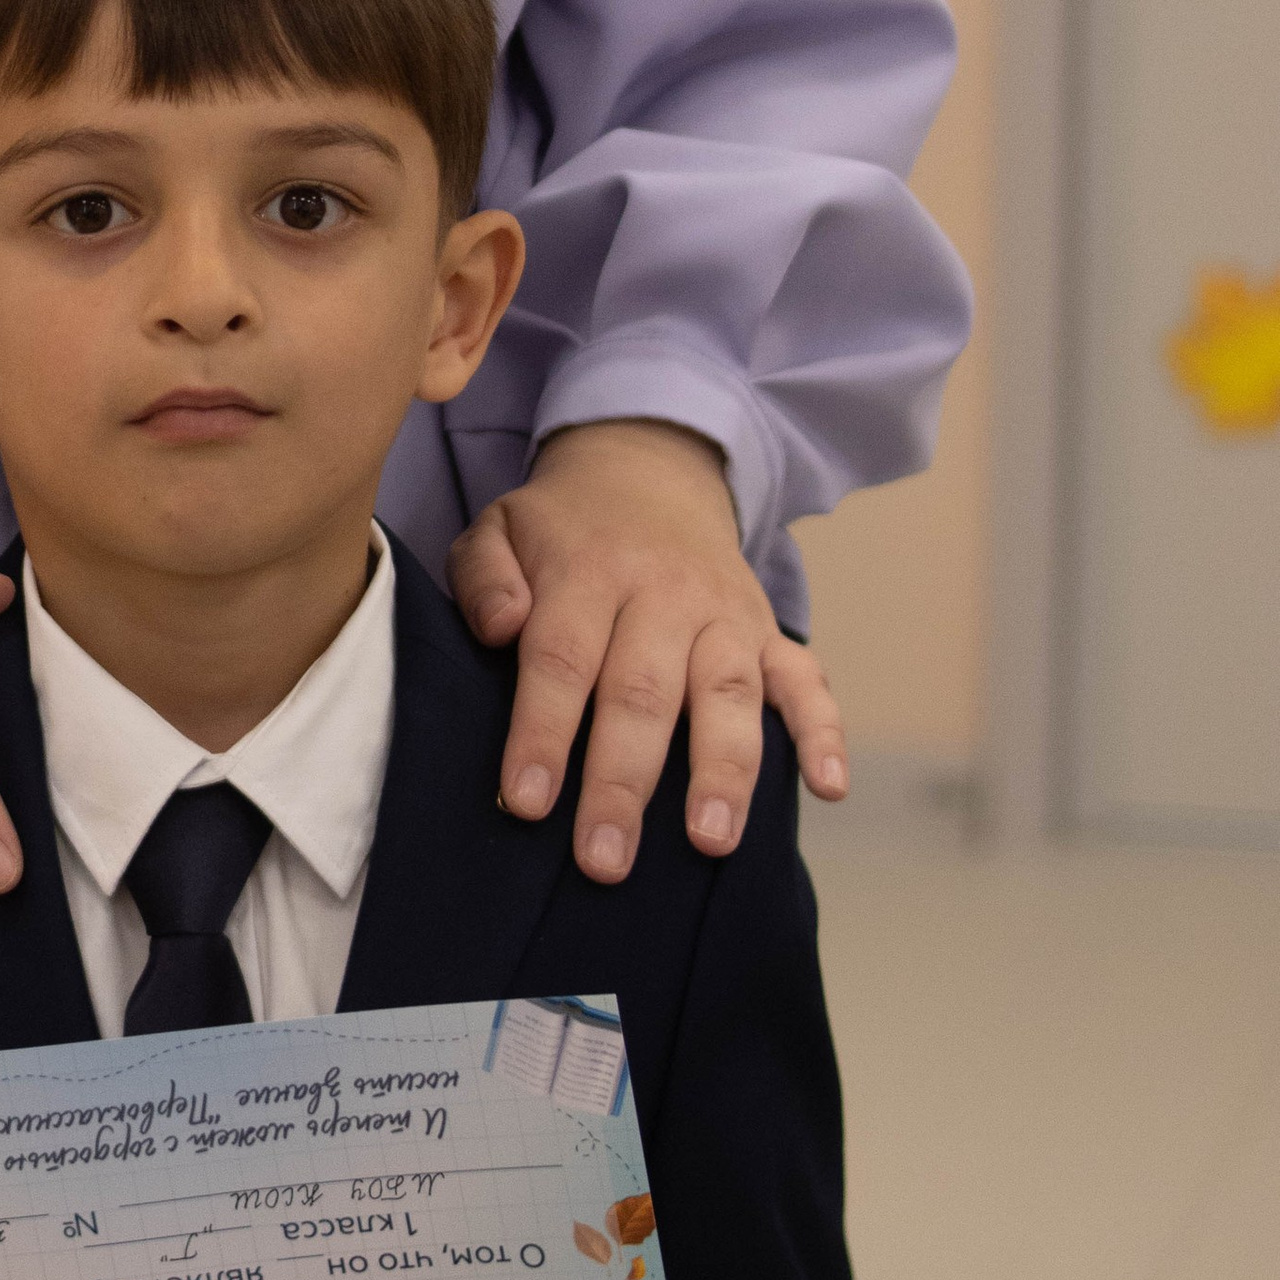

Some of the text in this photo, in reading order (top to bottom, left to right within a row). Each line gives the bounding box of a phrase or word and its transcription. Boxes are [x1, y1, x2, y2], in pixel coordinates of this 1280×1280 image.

[236, 1066, 341, 1116] звание
[354, 1070, 460, 1098] носить
[4, 1099, 447, 1172] И теперь может с гордостью
[62, 1211, 99, 1239] №
[280, 1213, 394, 1240] класса
[404, 1212, 418, 1236] 1
[327, 1254, 369, 1274] он
[378, 1253, 434, 1271] что
[442, 1243, 512, 1264] том,
[520, 1243, 546, 1269] О
